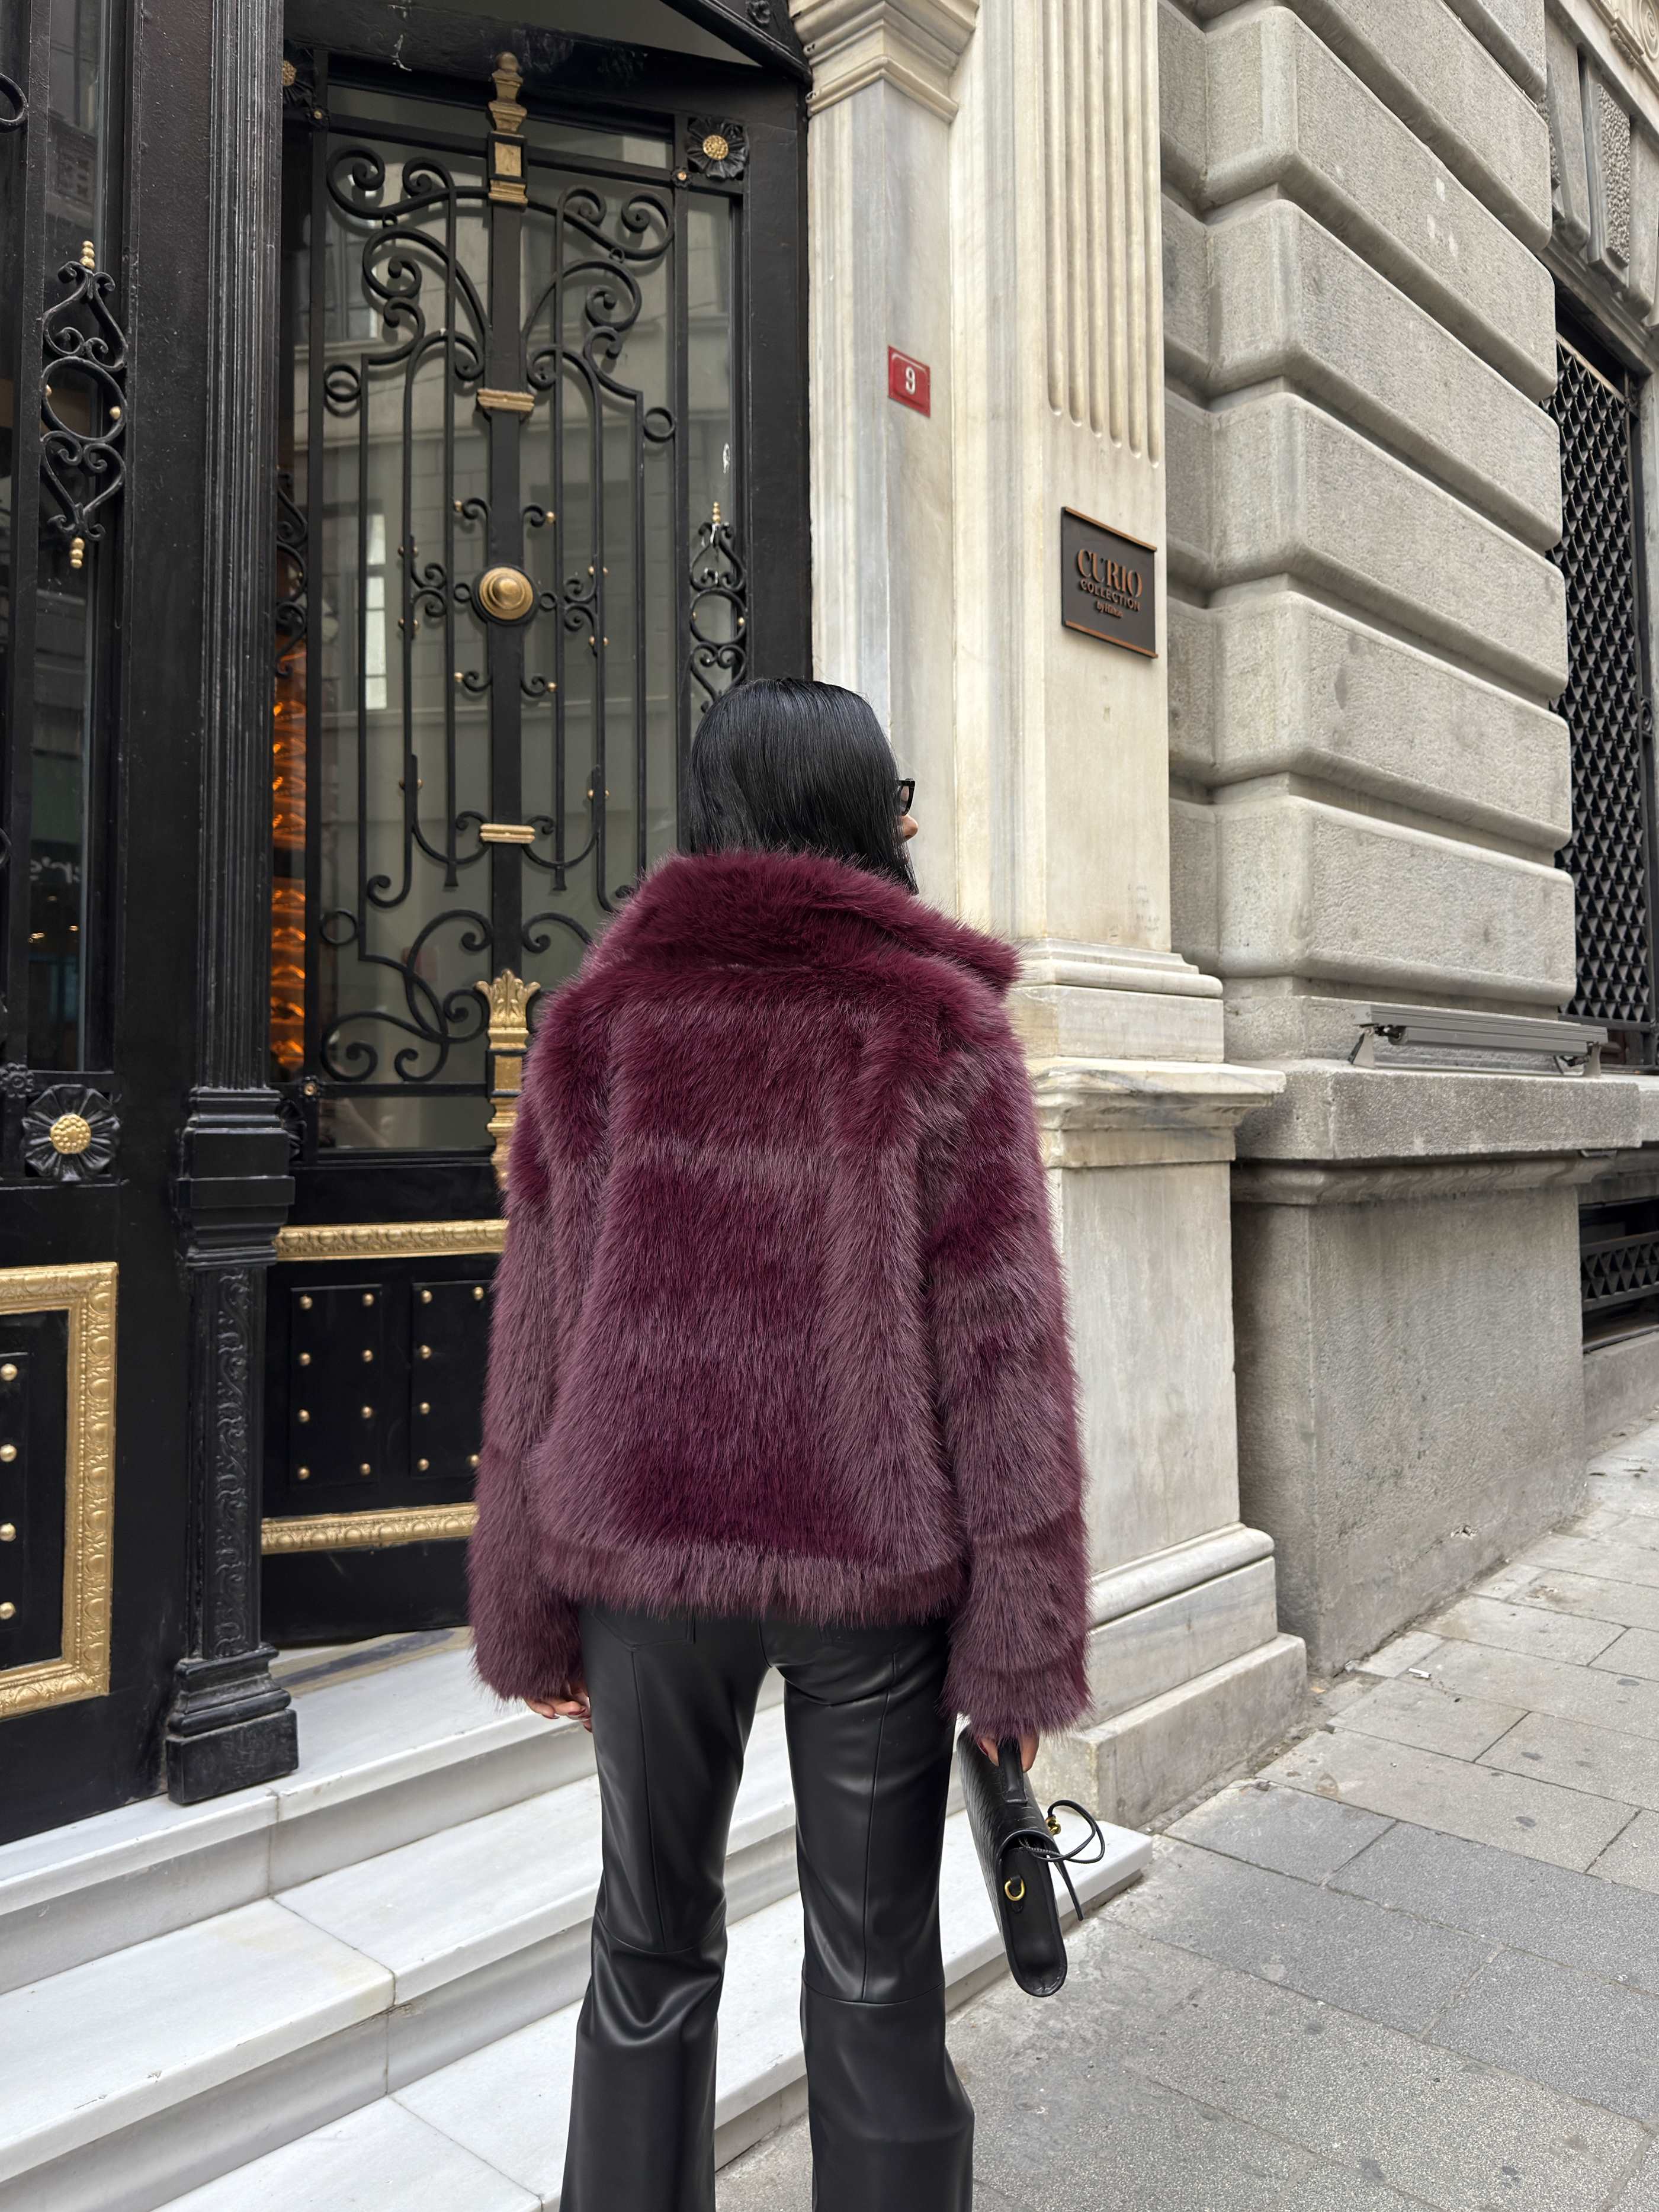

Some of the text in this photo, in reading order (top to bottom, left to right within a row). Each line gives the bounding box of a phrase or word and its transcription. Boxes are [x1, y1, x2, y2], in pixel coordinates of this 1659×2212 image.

[906, 366, 915, 394] 9
[1078, 549, 1143, 598] CURIO
[1080, 579, 1141, 611] COLLECTION
